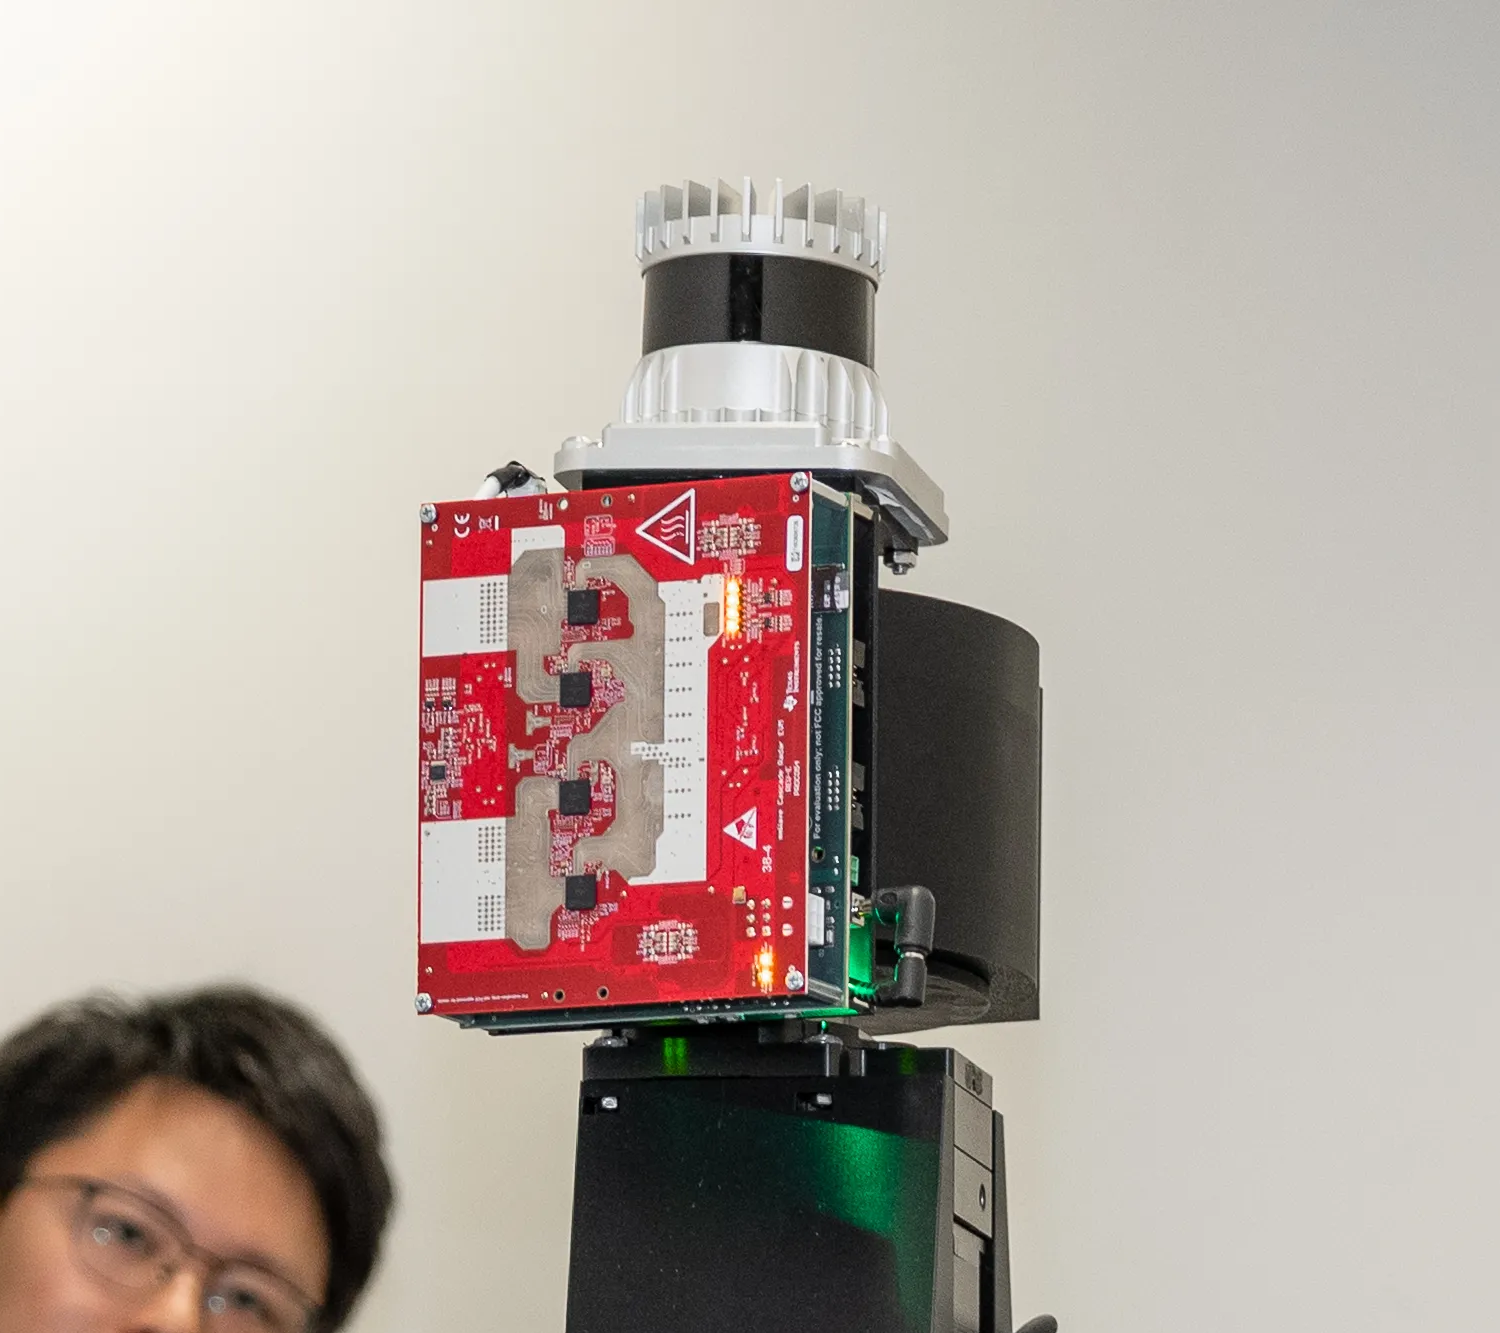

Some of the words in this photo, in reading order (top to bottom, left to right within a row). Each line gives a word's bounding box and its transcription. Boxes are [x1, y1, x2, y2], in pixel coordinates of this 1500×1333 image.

[815, 614, 823, 646] resale.
[814, 647, 822, 661] for
[814, 662, 823, 707] approved
[814, 708, 822, 729] FCC
[814, 730, 822, 746] not
[813, 773, 821, 822] evaluation
[813, 823, 821, 840] For
[761, 844, 773, 873] 38-4
